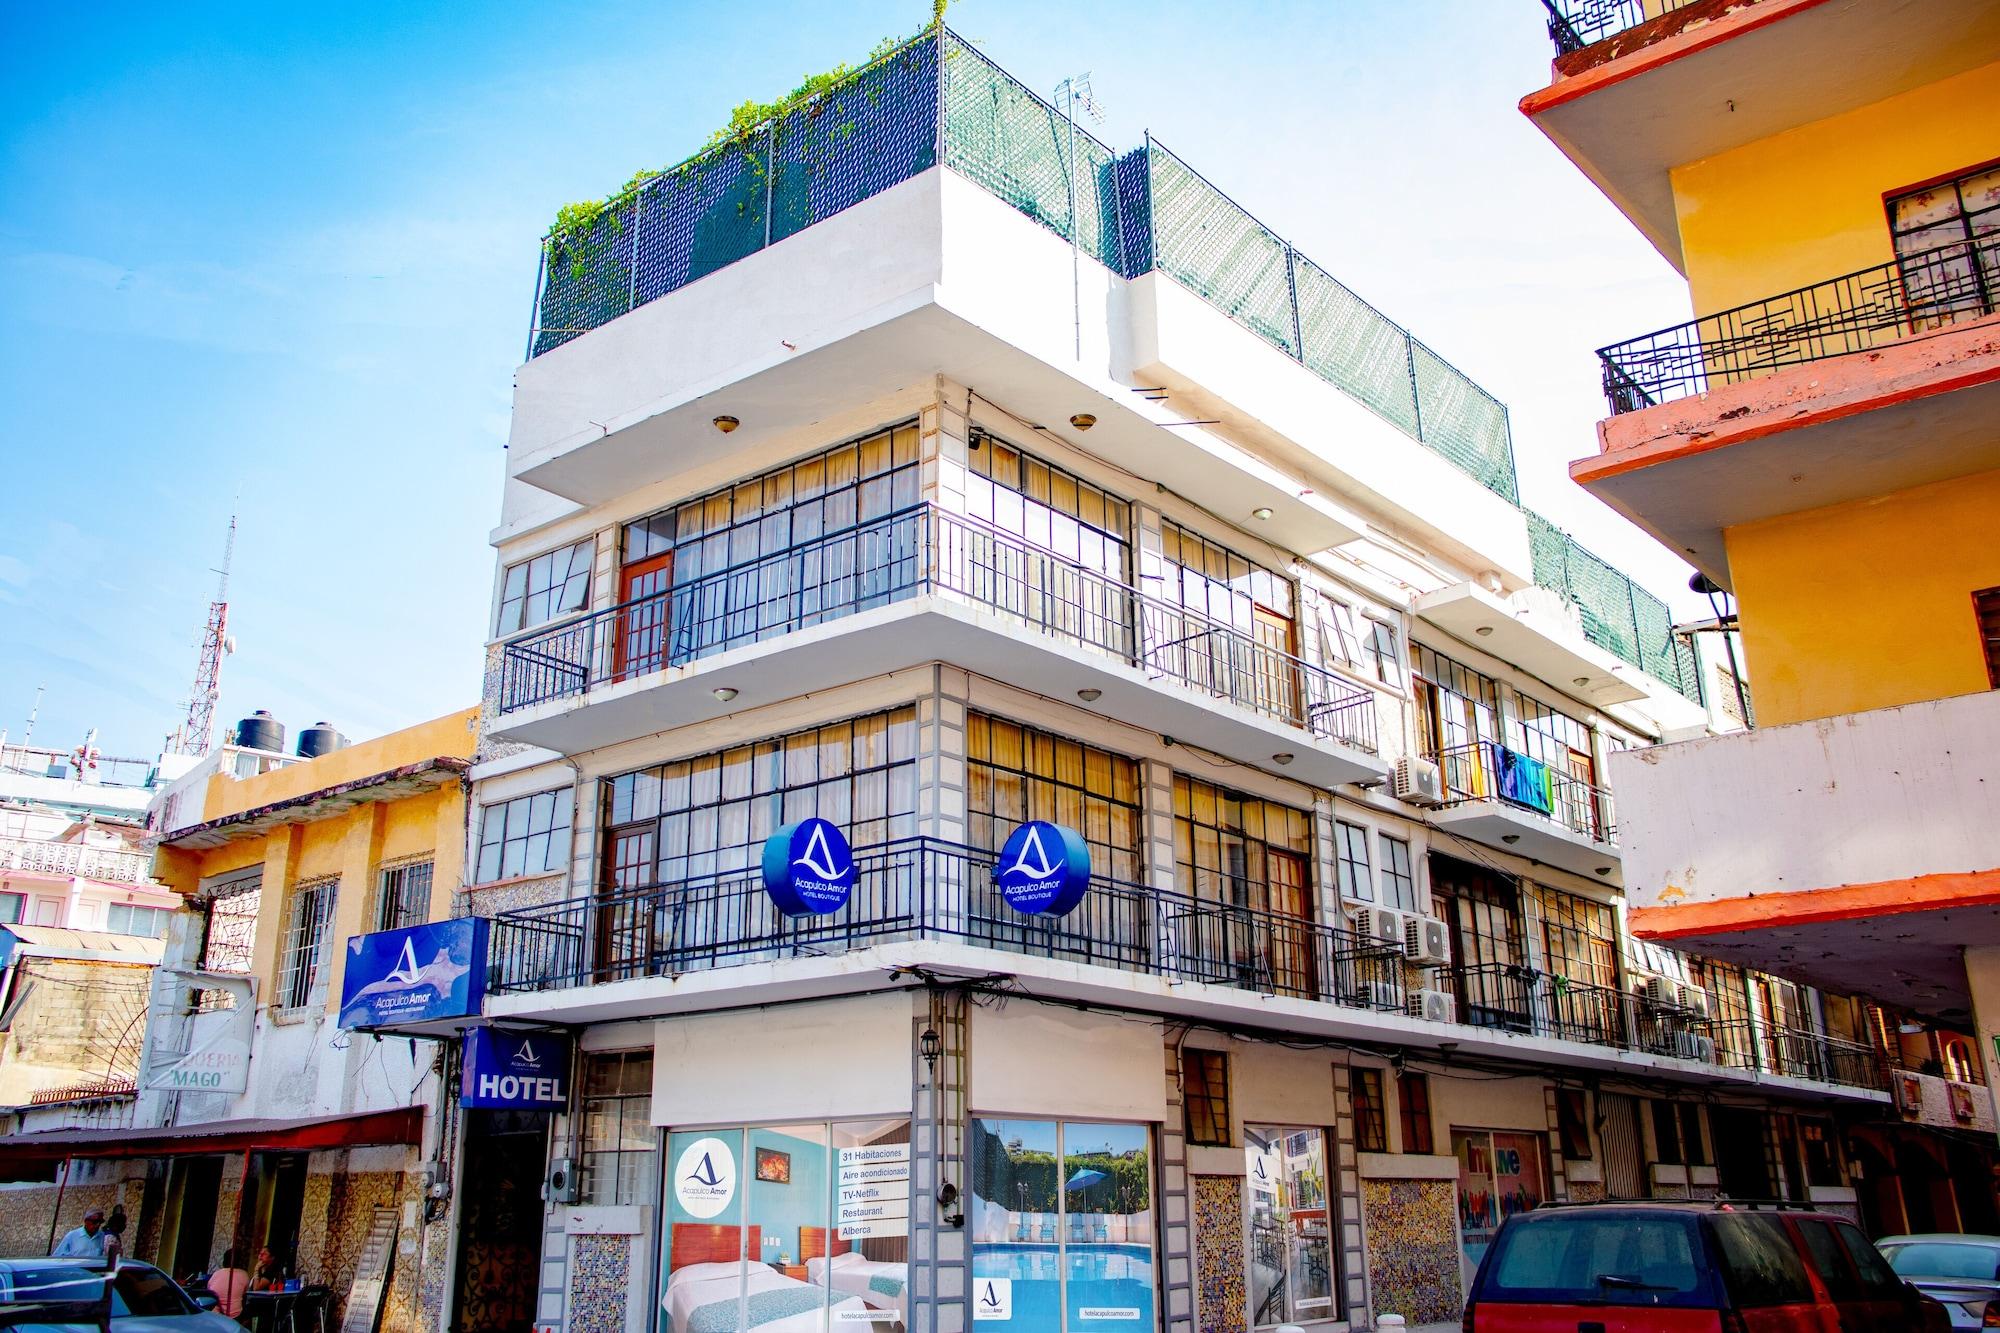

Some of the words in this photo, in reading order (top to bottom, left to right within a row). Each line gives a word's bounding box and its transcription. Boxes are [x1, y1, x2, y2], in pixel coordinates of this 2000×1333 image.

[795, 877, 827, 891] Acapulco
[827, 882, 847, 894] Amor
[1005, 883, 1038, 895] Acapulco
[1039, 880, 1060, 890] Amor
[375, 995, 408, 1010] Acapulco
[409, 992, 431, 1005] Amor
[479, 1073, 567, 1102] HOTEL
[842, 1152, 852, 1162] 31
[854, 1149, 902, 1160] Habitaciones
[843, 1171, 859, 1180] Aire
[860, 1167, 908, 1178] acondicionado
[710, 1187, 727, 1196] Amor
[843, 1188, 880, 1200] TV-Netflix
[842, 1206, 883, 1218] Restaurant
[842, 1226, 871, 1236] Alberca
[1084, 1310, 1135, 1319] hotelacapulcoamor.com
